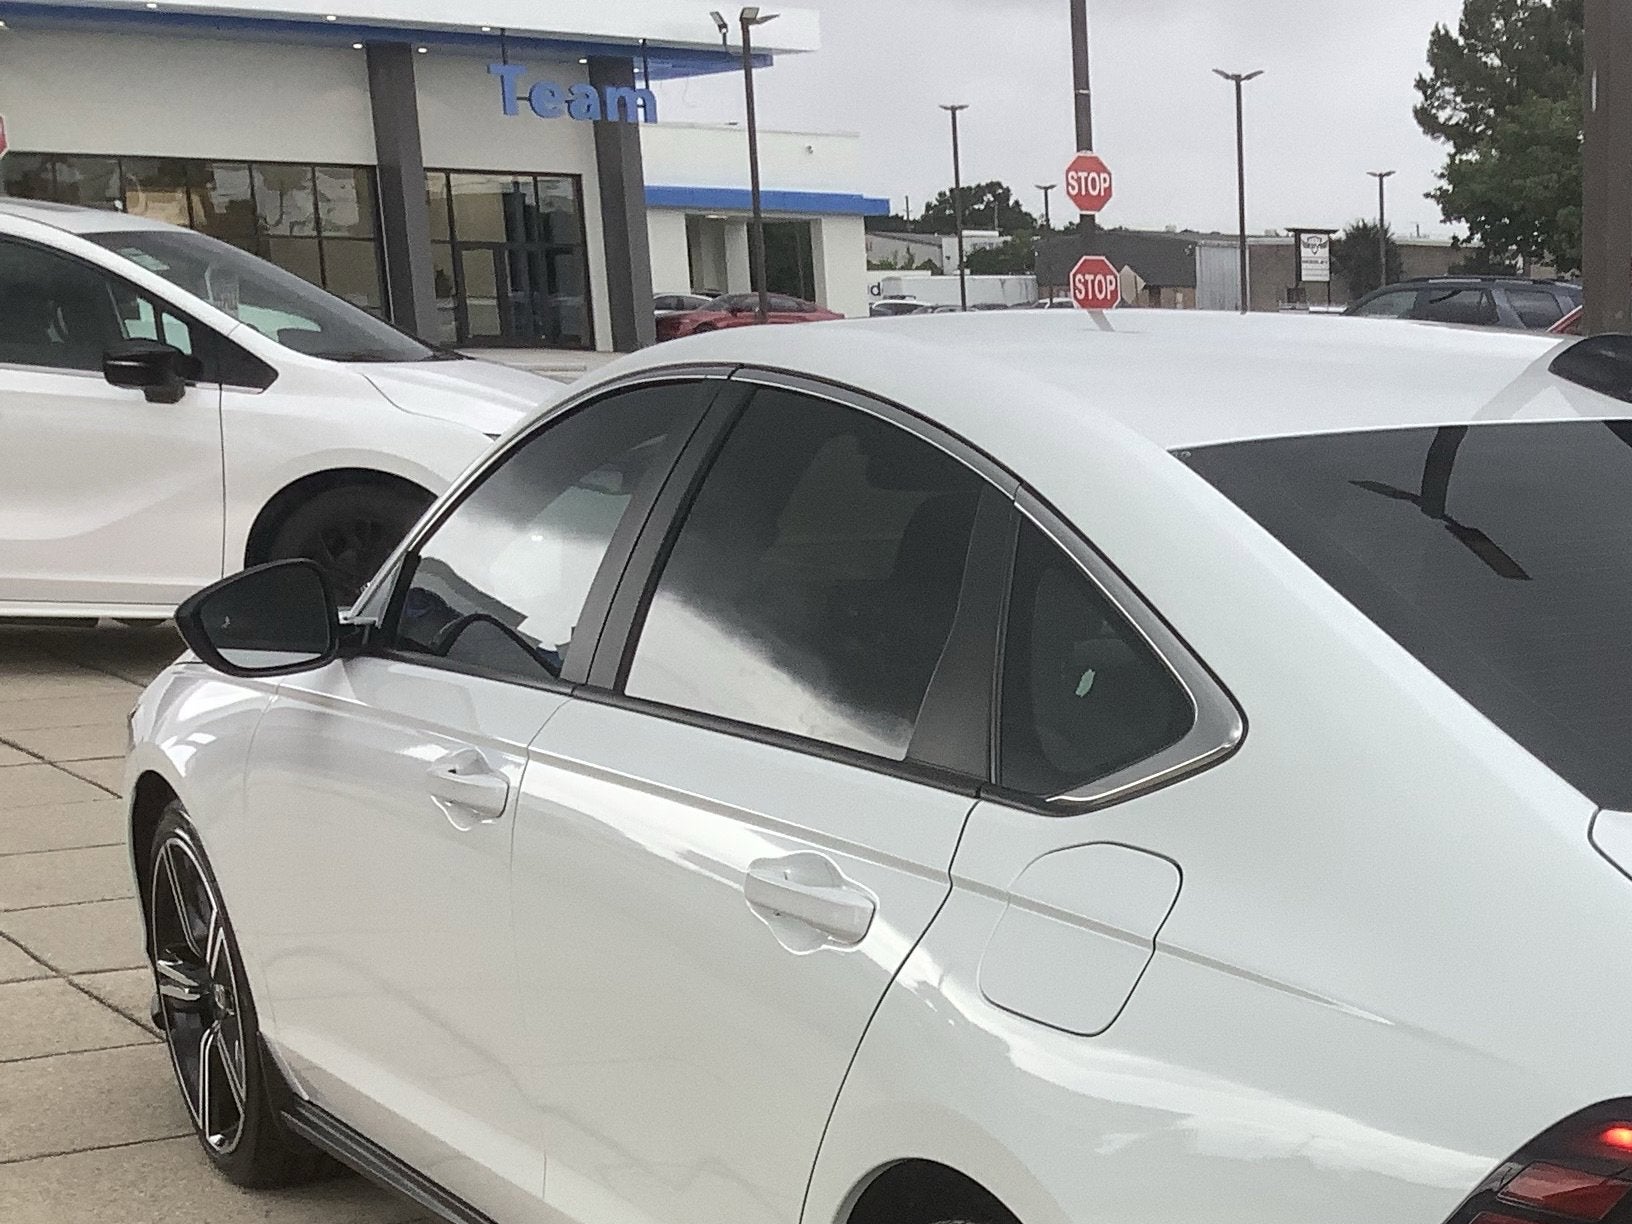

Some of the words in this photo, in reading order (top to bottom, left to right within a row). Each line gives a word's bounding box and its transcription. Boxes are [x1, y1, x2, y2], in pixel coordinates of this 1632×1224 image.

[486, 64, 658, 124] Team
[1068, 170, 1111, 197] STOP
[1075, 273, 1117, 301] STOP
